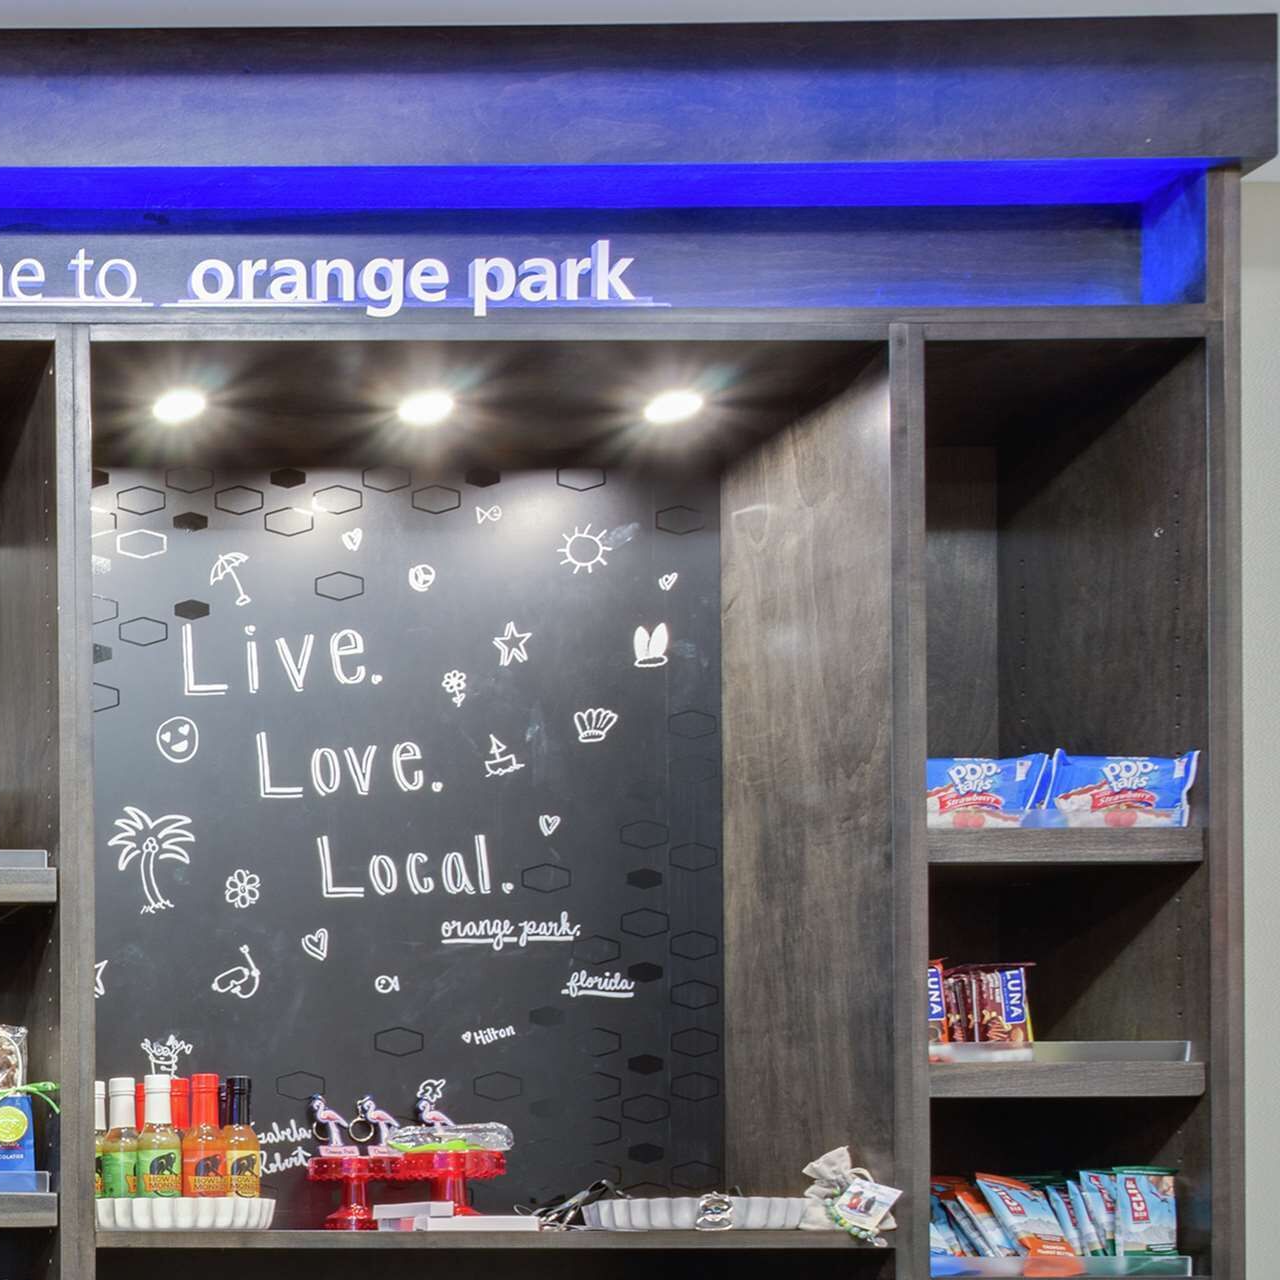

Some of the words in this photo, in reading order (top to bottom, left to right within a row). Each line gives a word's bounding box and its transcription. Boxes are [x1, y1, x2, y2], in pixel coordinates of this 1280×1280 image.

[70, 248, 137, 303] to
[190, 254, 448, 317] orange
[469, 239, 636, 317] park
[181, 623, 383, 696] Live.
[256, 731, 443, 798] Love.
[945, 792, 997, 808] Strawberry
[1100, 791, 1151, 806] Strawberry
[316, 834, 515, 898] Local.
[441, 919, 514, 951] orange
[565, 969, 635, 998] florida
[1005, 969, 1023, 1018] LUNA
[473, 1025, 516, 1046] Hilton
[254, 1119, 313, 1144] zabela
